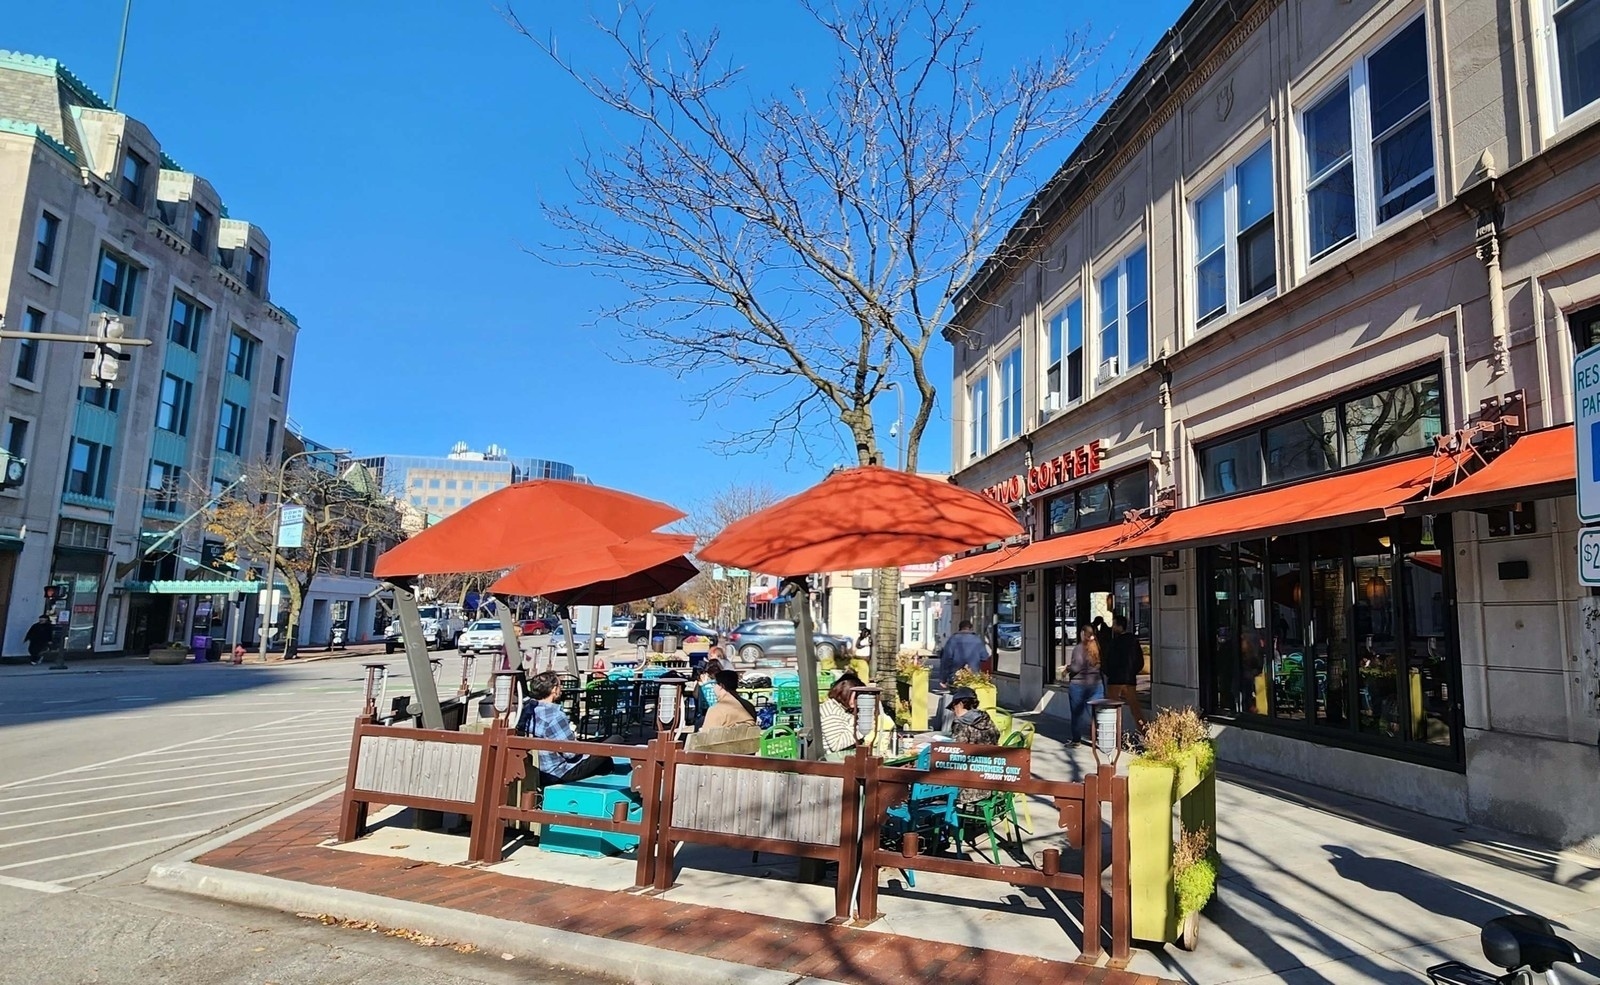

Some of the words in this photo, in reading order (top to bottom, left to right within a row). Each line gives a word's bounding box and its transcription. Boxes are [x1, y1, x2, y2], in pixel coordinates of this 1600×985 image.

[1027, 439, 1104, 495] COFFEE
[949, 754, 966, 762] PATIO
[967, 755, 992, 765] SEATING
[993, 757, 1006, 766] FOR
[935, 761, 967, 770] COLECTIVO
[969, 764, 1004, 773] CUSTOMERS
[1005, 766, 1021, 775] ONLY
